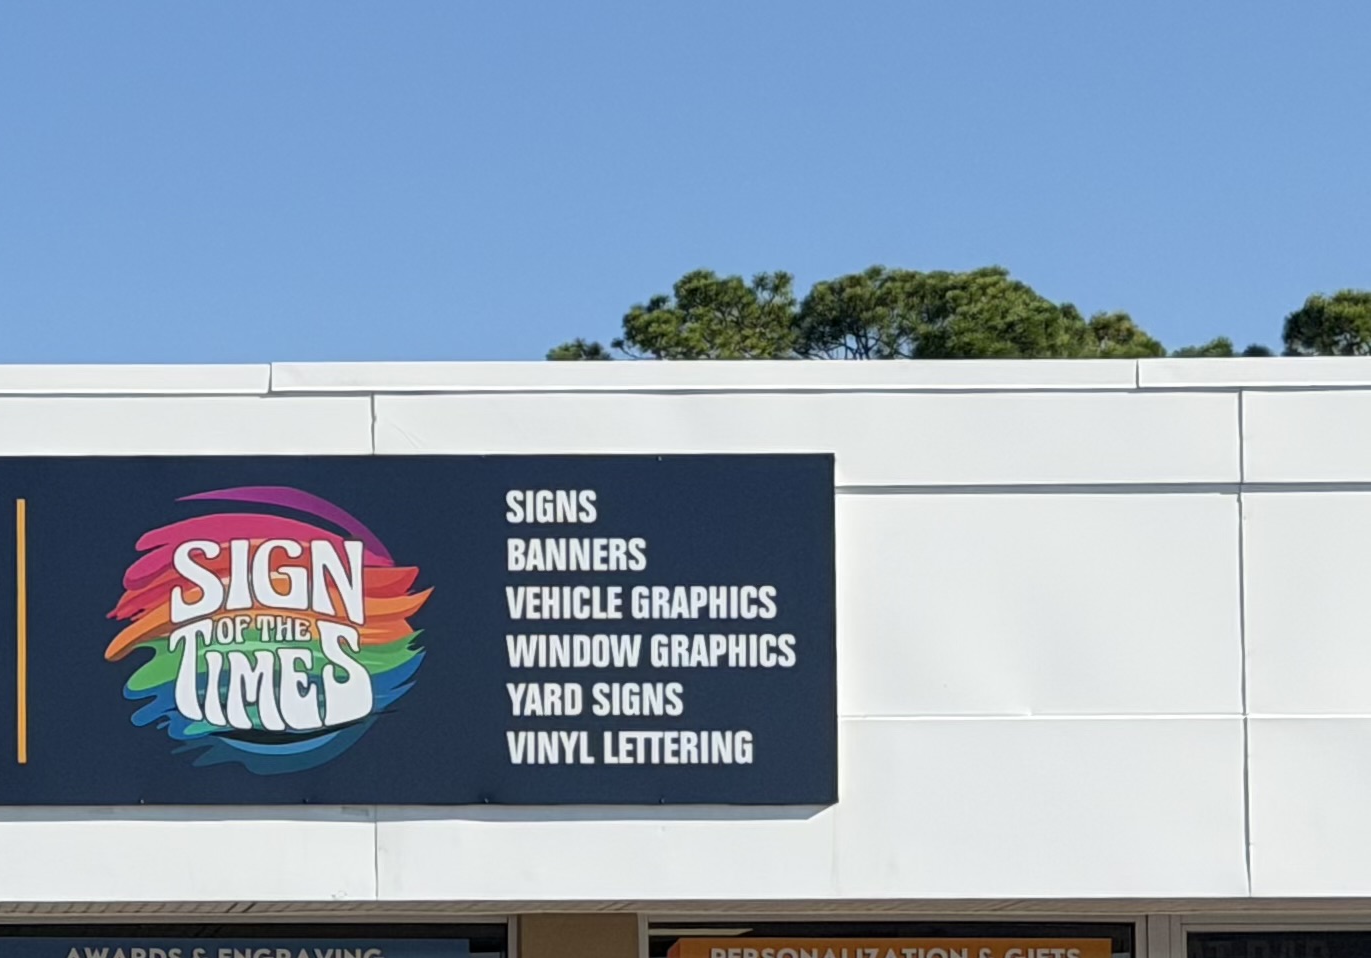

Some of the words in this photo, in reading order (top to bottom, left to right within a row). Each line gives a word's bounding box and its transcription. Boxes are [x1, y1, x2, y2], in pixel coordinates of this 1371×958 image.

[505, 489, 598, 524] SIGNS
[507, 537, 647, 572] BANNERS
[170, 539, 365, 626] SIGN
[505, 585, 623, 620] VEHICLE
[631, 585, 777, 620] GRAPHICS
[216, 615, 252, 645] OF
[256, 614, 312, 643] THE
[505, 633, 643, 668] WINDOW
[650, 633, 797, 668] GRAPHICS
[168, 618, 374, 732] TIMES
[506, 682, 583, 717] YARD
[591, 682, 684, 717] SIGNS
[506, 730, 595, 765] VINYL
[603, 730, 753, 765] LETTERING
